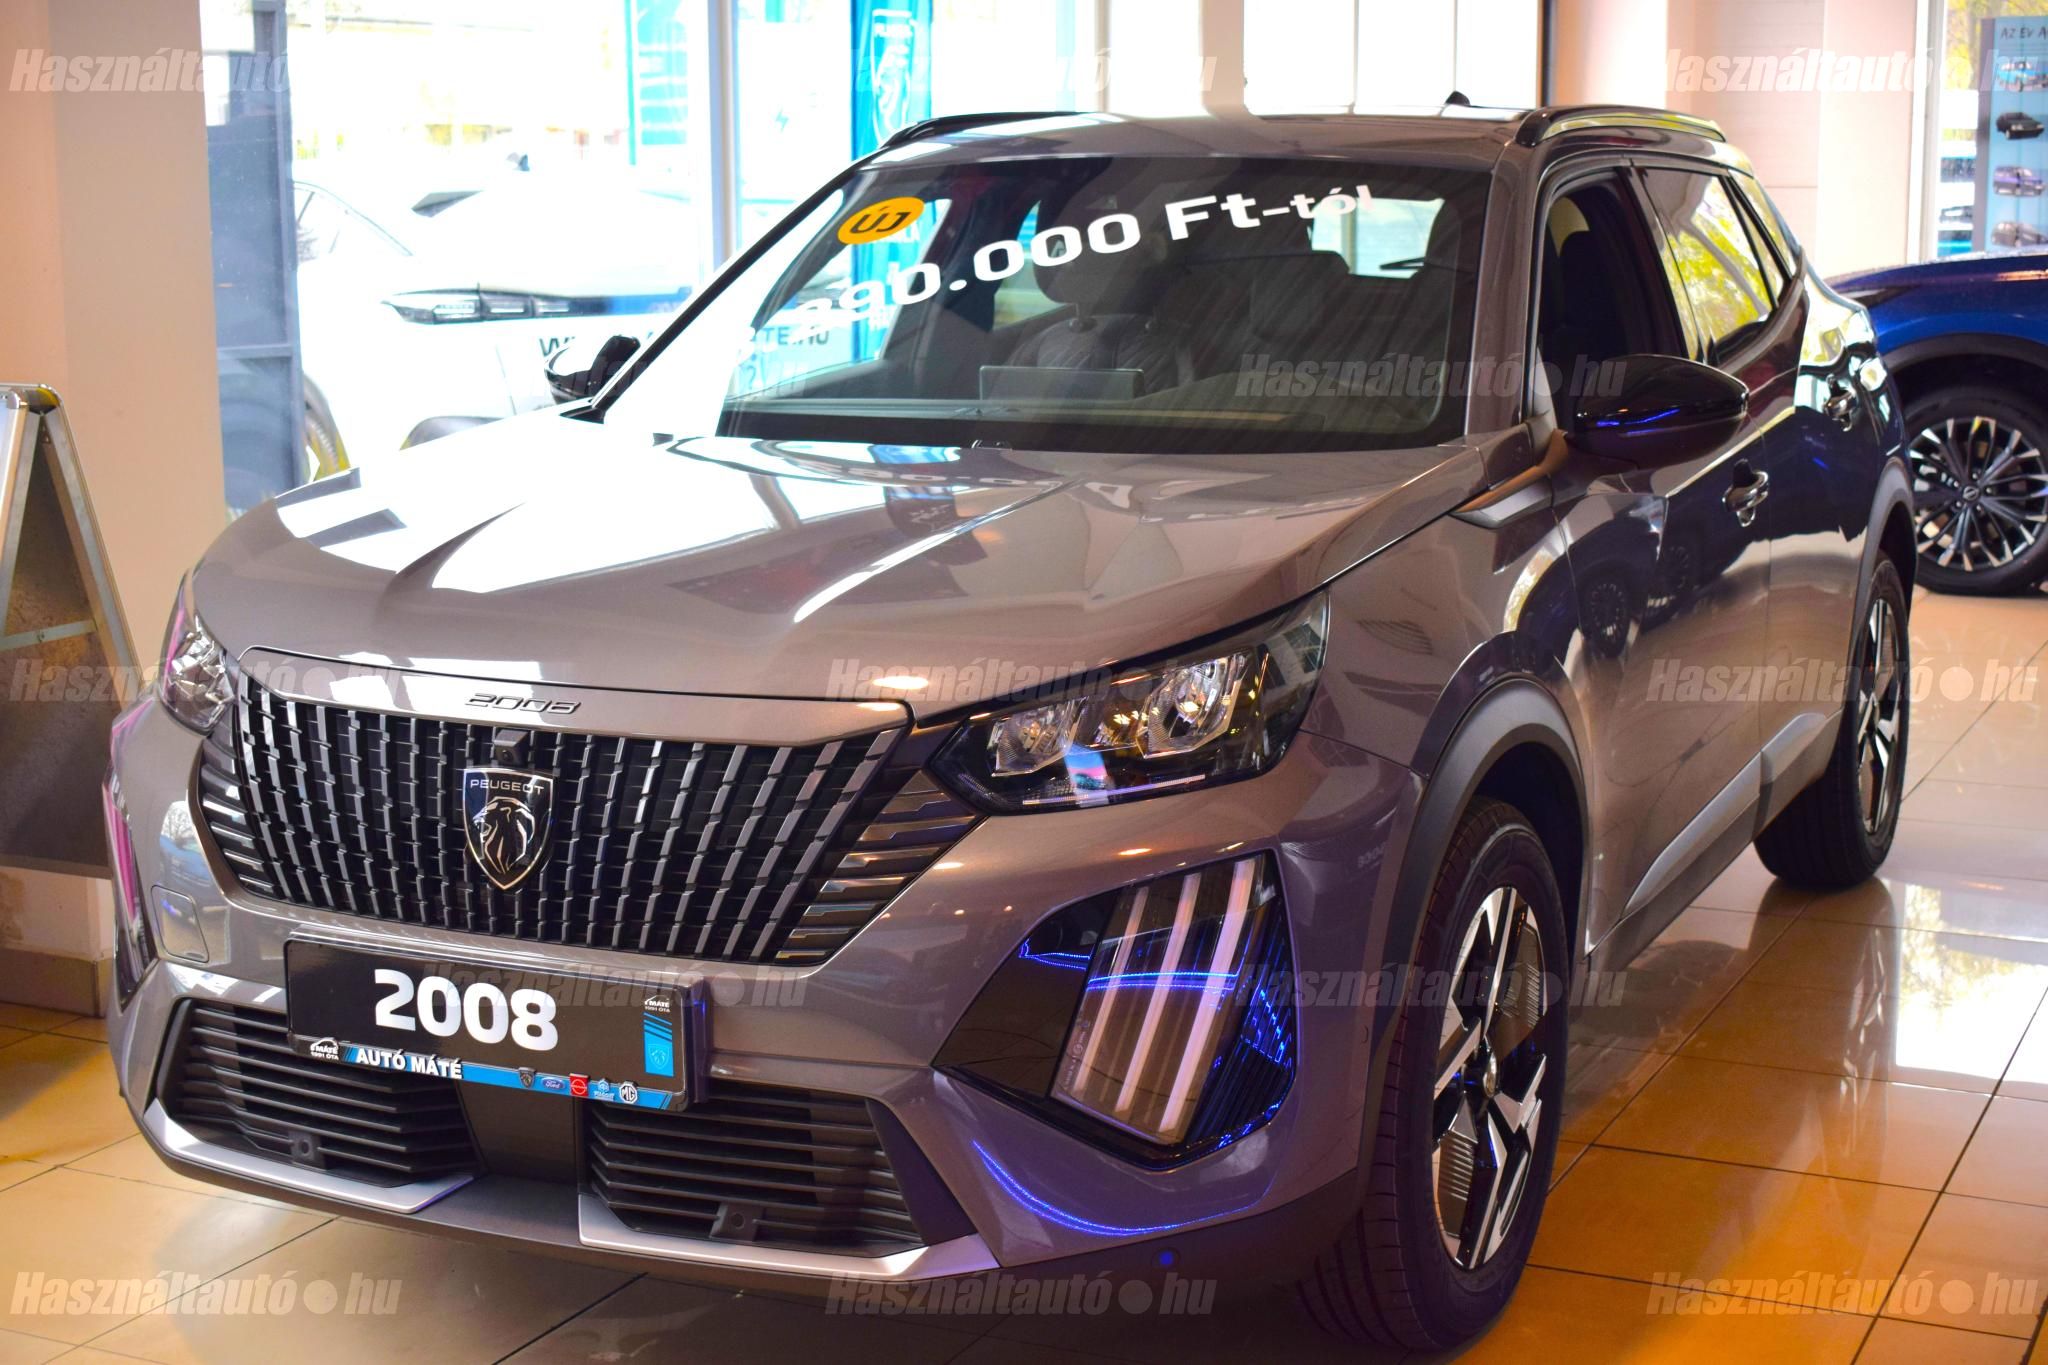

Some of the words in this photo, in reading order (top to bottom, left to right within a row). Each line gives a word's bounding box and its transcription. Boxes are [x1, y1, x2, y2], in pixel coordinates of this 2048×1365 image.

[464, 692, 582, 715] 2008
[470, 779, 544, 795] PEUGEOT
[374, 968, 558, 1051] 2008
[356, 1048, 406, 1070] AUTÓ
[411, 1053, 463, 1080] MÁTÉ
[621, 1085, 637, 1102] MG
